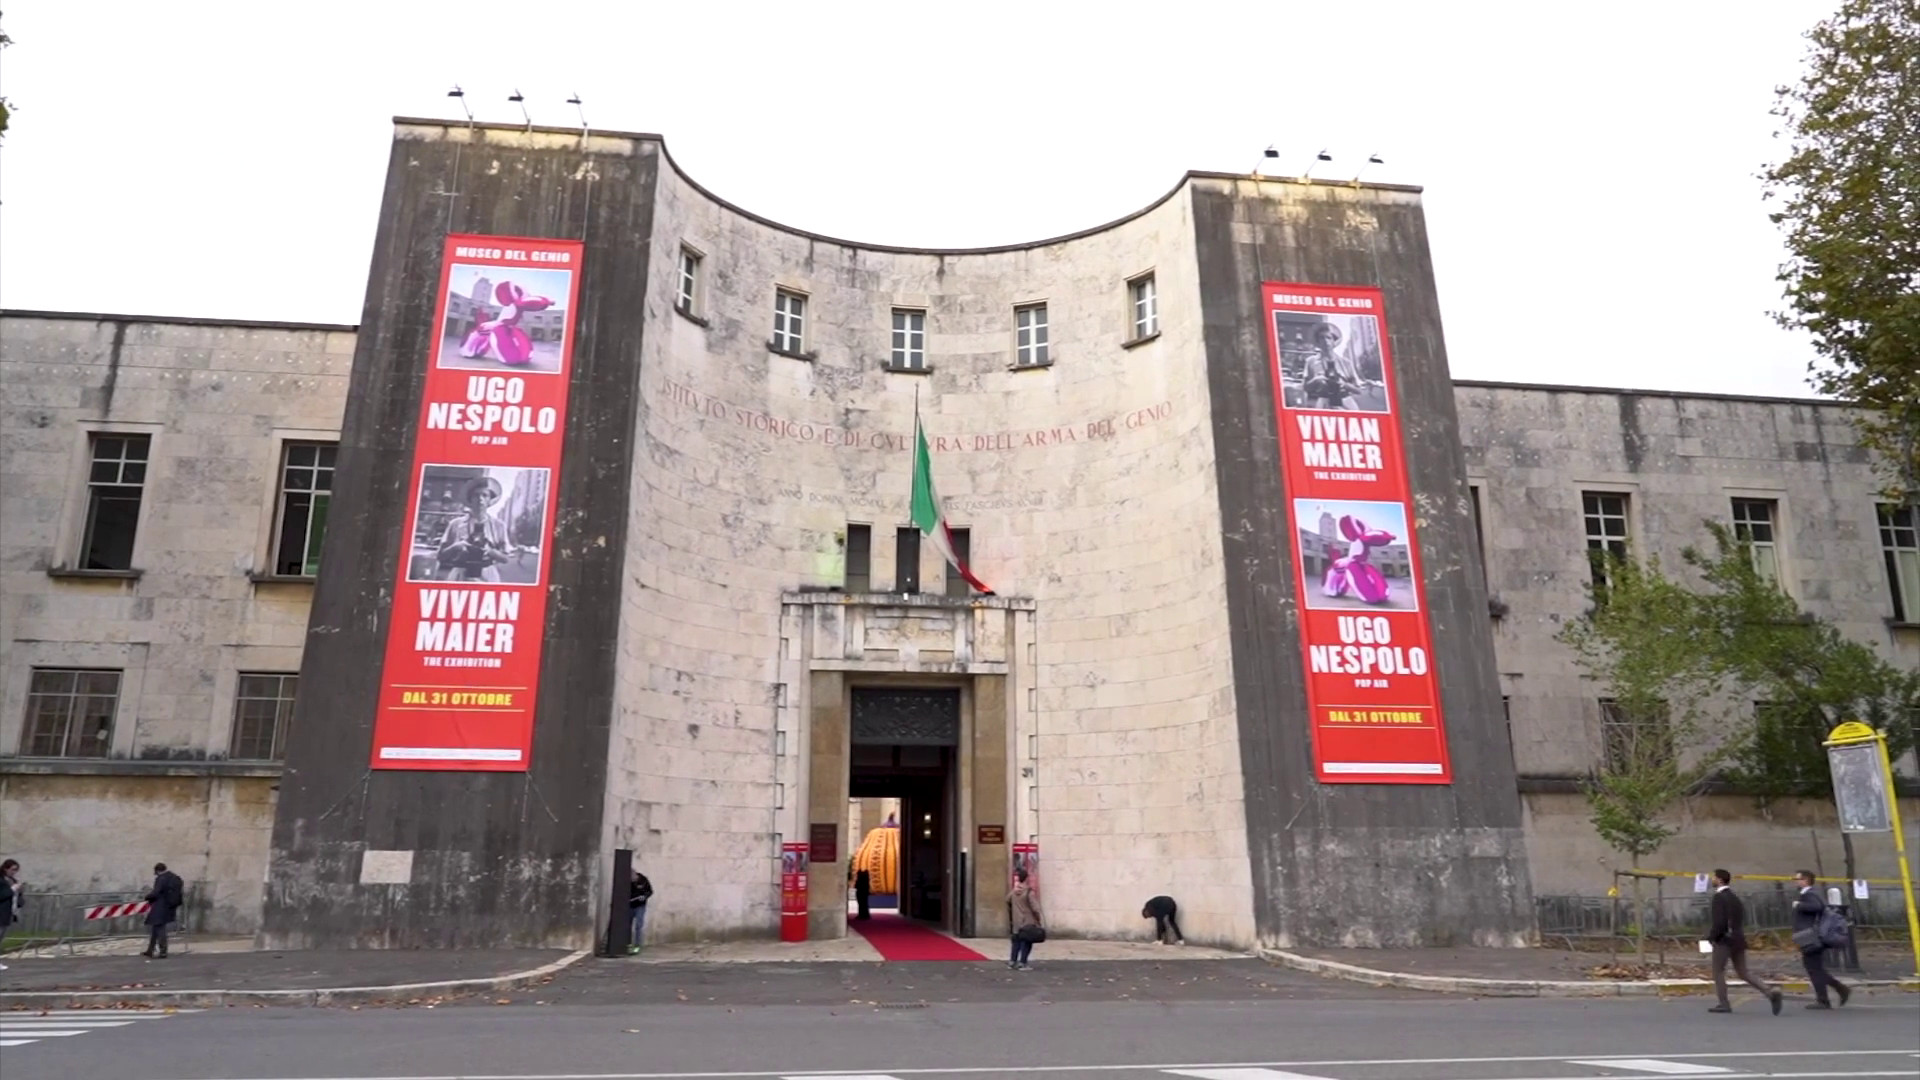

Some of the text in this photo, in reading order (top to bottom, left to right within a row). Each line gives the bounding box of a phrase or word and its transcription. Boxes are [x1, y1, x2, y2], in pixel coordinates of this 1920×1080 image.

[456, 246, 570, 263] MUSEO DEL GENIO
[1273, 294, 1373, 309] MUSEO DEL GENIO
[467, 376, 525, 404] UGO
[427, 402, 557, 435] NESPOLO
[661, 377, 726, 419] ISTITVTO
[736, 409, 814, 440] STORICO
[824, 428, 834, 444] E
[844, 431, 860, 447] DI
[1087, 418, 1116, 440] DEL
[1125, 400, 1173, 430] GENIO
[471, 435, 509, 446] POP AIR
[1297, 414, 1381, 443] VIVIAN
[1302, 442, 1383, 469] MAIER
[1314, 471, 1377, 481] THE EXHIBITION
[419, 589, 521, 621] VIVIAN
[415, 621, 515, 653] MAIER
[1337, 616, 1391, 644] UGO
[424, 656, 502, 668] THE EXHIBITION
[1309, 644, 1428, 676] NESPOLO
[1355, 678, 1389, 688] POP AIR
[402, 692, 513, 706] DAL 31 OTTOBRE
[1329, 711, 1422, 723] DAL 31 OTTOBRE
